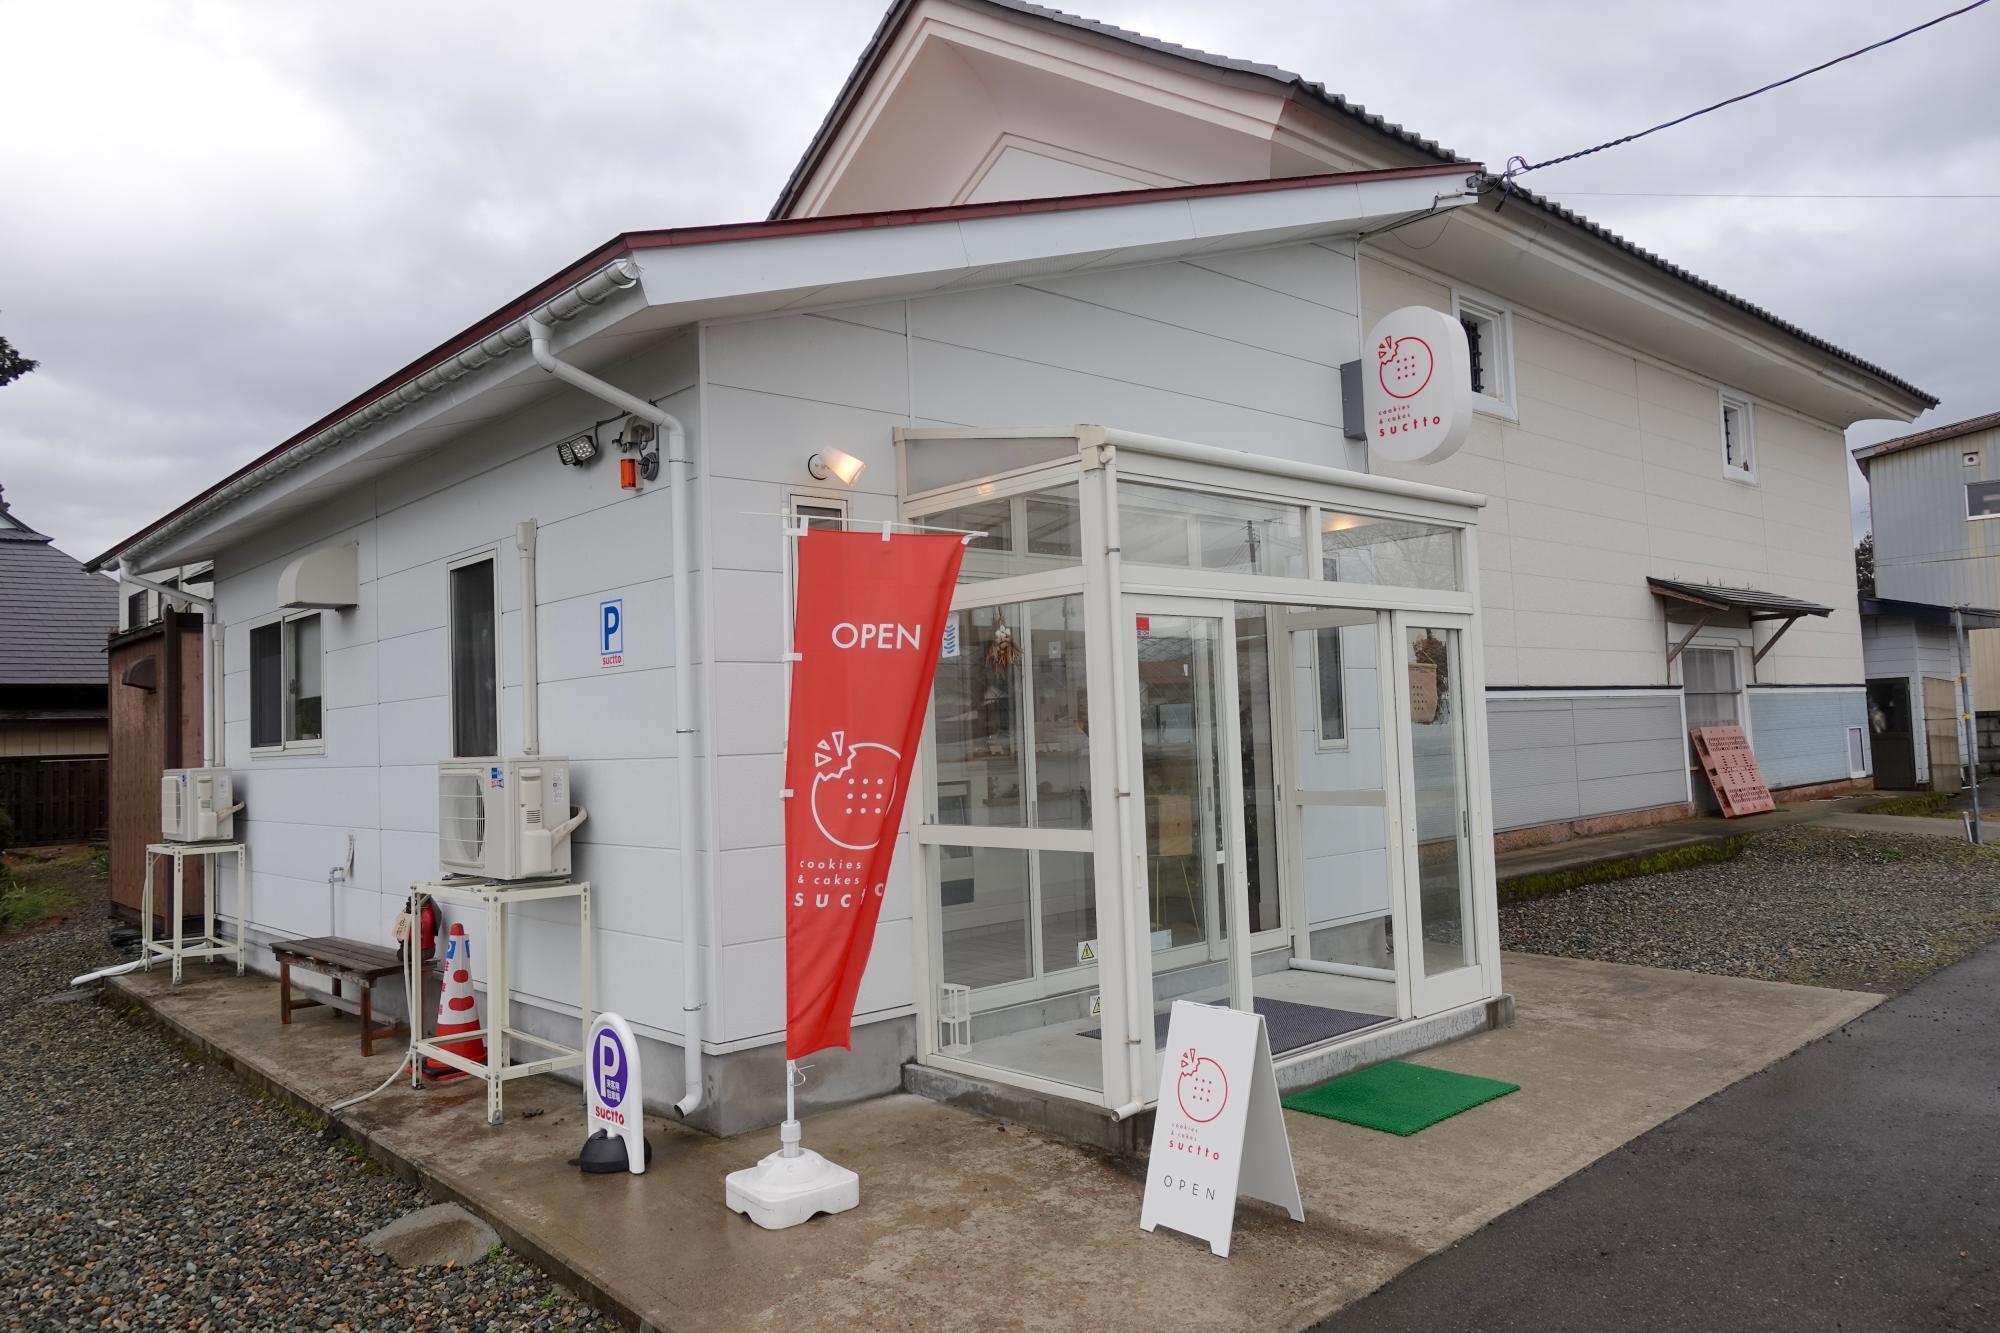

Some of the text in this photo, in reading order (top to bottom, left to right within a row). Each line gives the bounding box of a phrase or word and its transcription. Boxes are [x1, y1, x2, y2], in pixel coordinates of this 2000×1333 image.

[1379, 404, 1410, 415] cookies
[1379, 416, 1440, 437] suctto
[604, 605, 620, 651] P
[831, 622, 921, 651] OPEN
[799, 858, 862, 870] cookies
[797, 874, 860, 885] & cakes
[599, 1034, 620, 1097] P
[1169, 1139, 1220, 1161] suctto
[1163, 1175, 1216, 1201] OPEN
